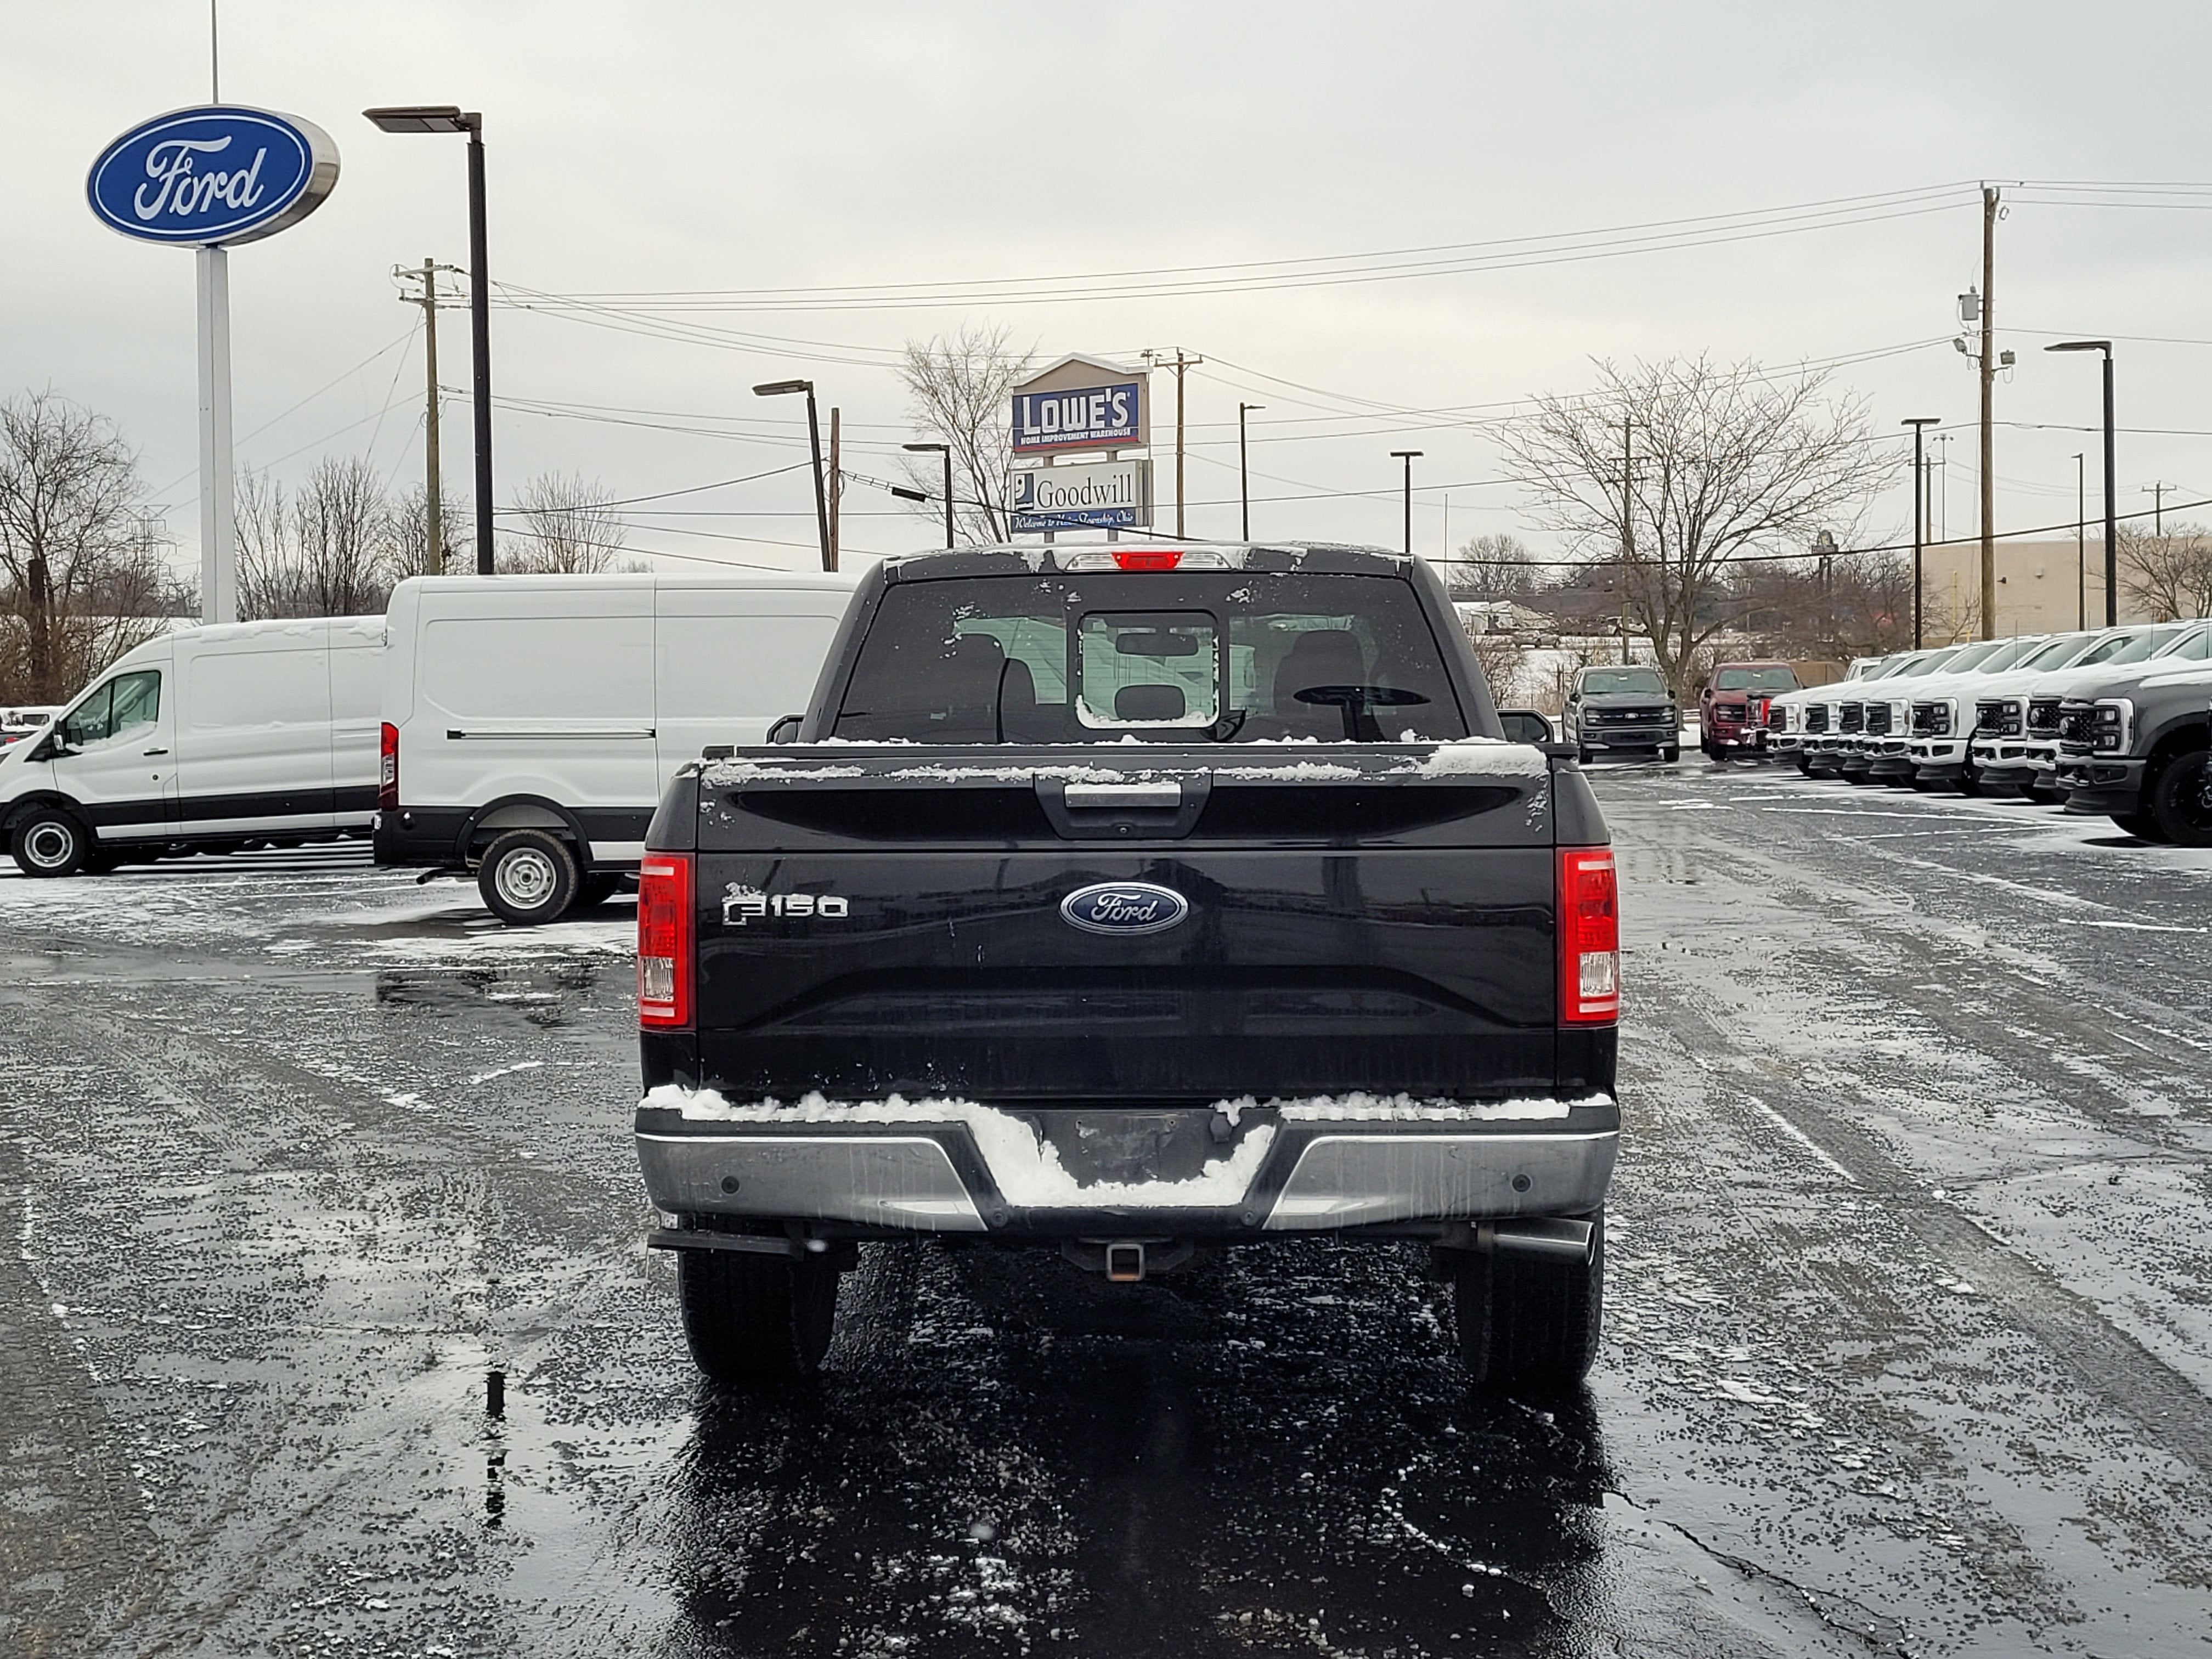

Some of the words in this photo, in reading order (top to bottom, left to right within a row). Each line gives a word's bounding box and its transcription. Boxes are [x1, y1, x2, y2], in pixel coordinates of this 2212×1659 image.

[134, 136, 267, 220] Ford
[1023, 388, 1128, 435] LOWE'S
[1020, 435, 1040, 445] HOME
[1042, 431, 1088, 442] IMPROVEMENT
[1090, 427, 1131, 438] WAREHOUSE
[1037, 473, 1132, 508] Goodwill
[1015, 516, 1046, 529] Welcome
[1047, 518, 1054, 527] to
[1090, 893, 1159, 922] Ford
